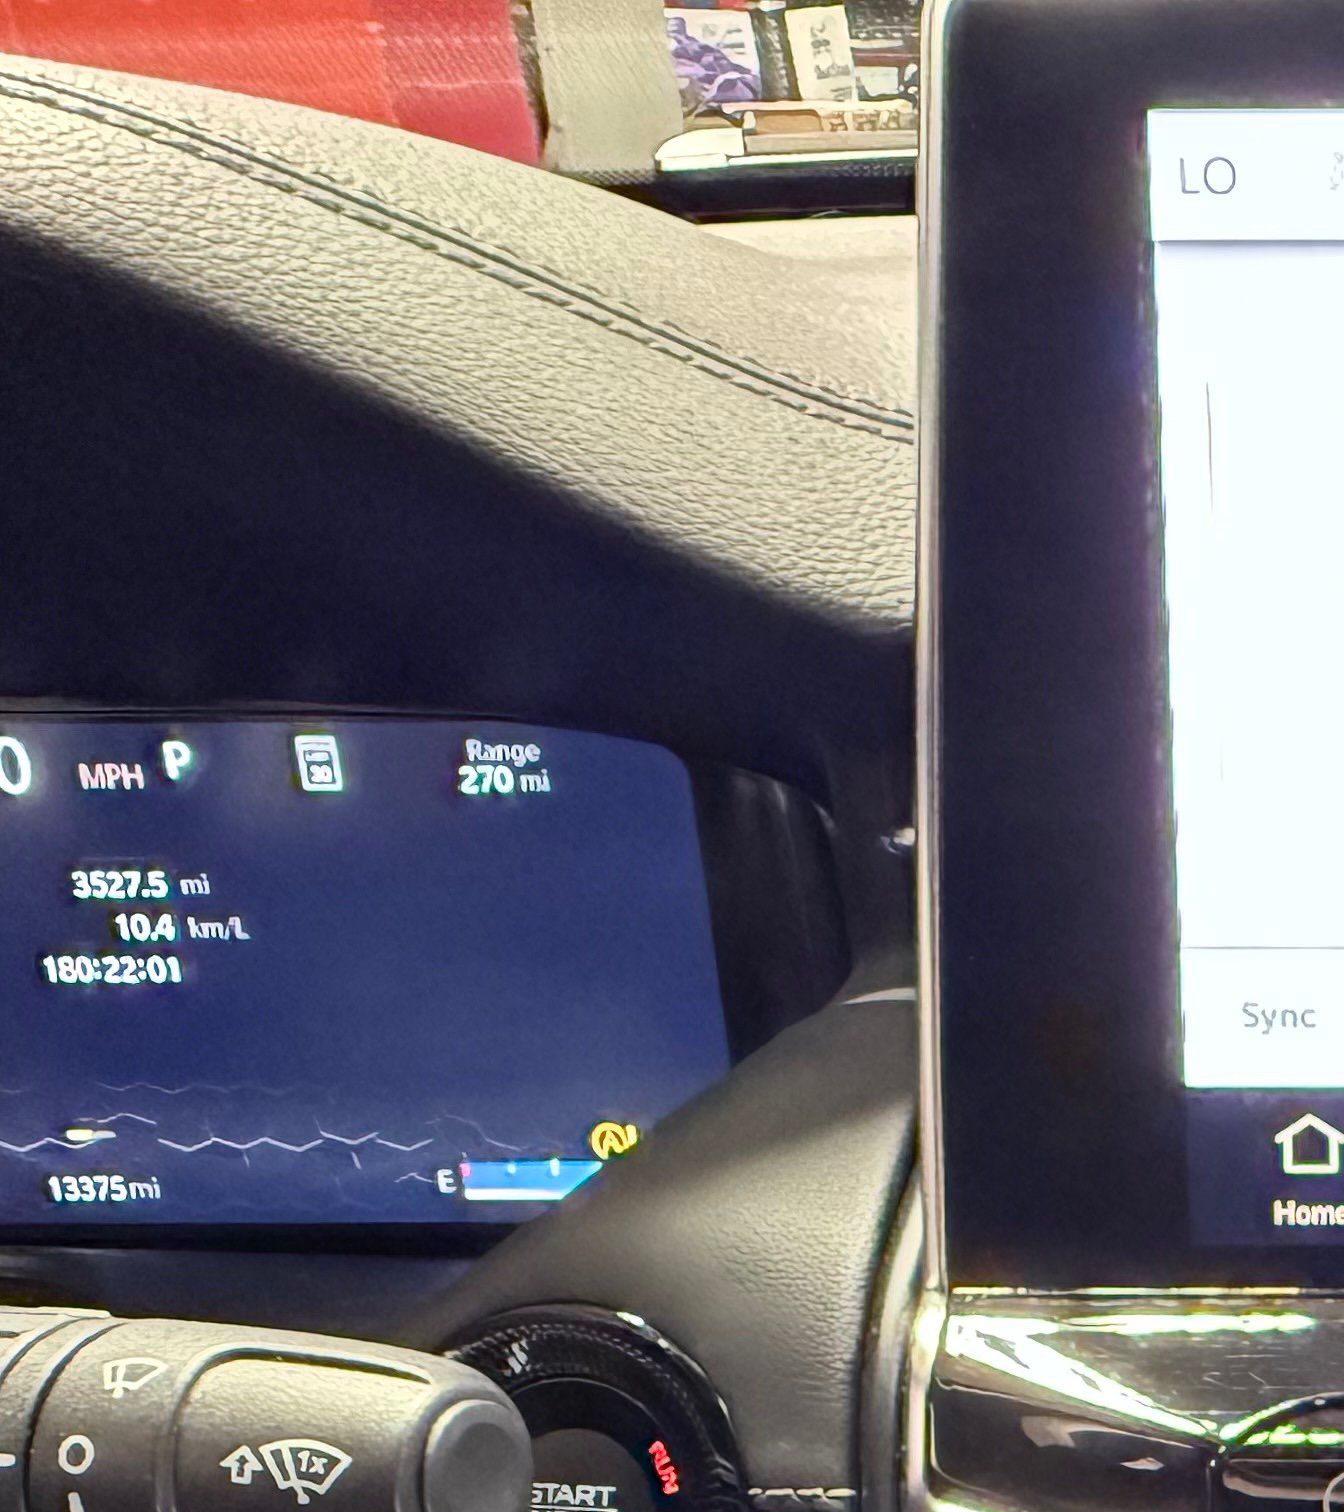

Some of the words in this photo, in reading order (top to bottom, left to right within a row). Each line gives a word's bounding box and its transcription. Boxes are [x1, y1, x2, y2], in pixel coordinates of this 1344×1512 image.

[1180, 157, 1235, 194] LO
[163, 741, 192, 779] P
[465, 739, 541, 767] Range
[79, 763, 144, 789] MPH
[458, 764, 514, 794] 270
[520, 769, 551, 792] mi
[72, 870, 168, 899] 3527.5
[180, 874, 210, 894] mi
[115, 913, 175, 941] 10.4
[187, 917, 250, 939] km/L
[43, 955, 181, 984] 180:22:01
[1242, 1003, 1315, 1034] Sync
[437, 1169, 456, 1193] E
[531, 1483, 617, 1507] START
